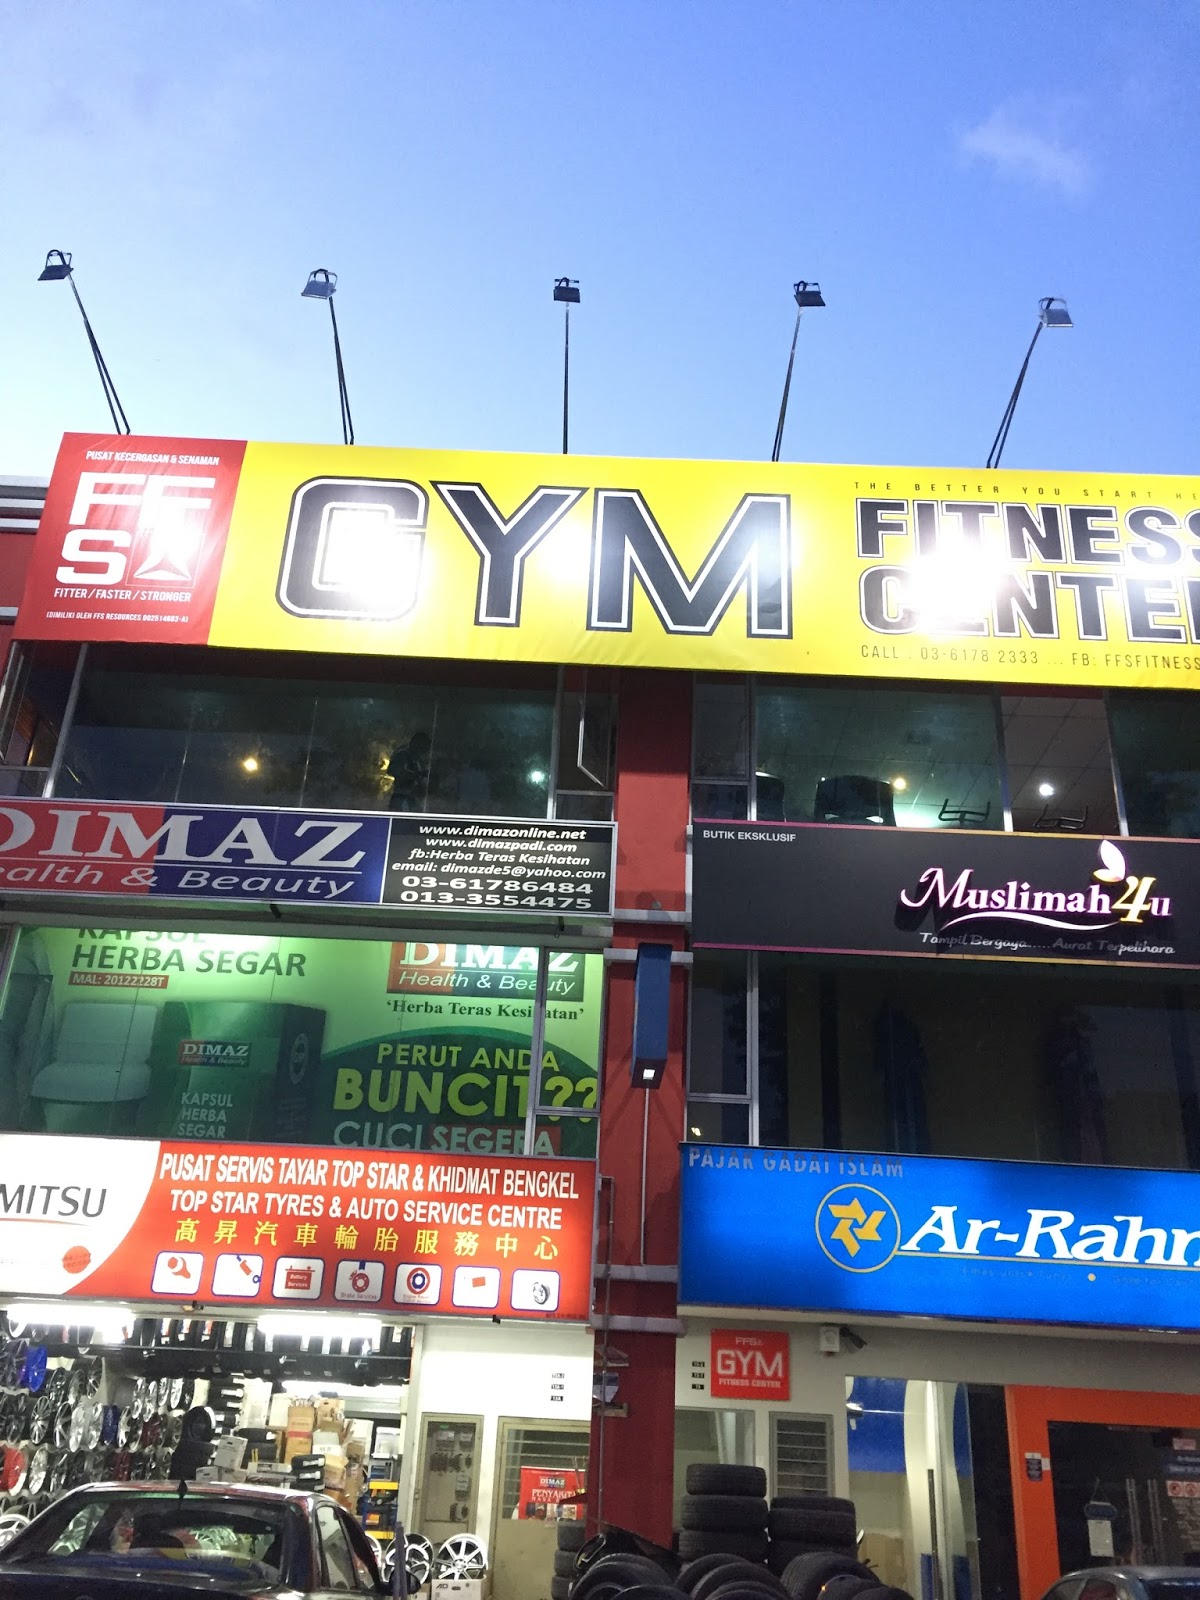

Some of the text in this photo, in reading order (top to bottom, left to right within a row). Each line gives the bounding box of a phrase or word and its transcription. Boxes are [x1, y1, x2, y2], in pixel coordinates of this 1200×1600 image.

[86, 450, 114, 461] PUSAT
[170, 455, 177, 464] &
[178, 456, 220, 466] SENAMAN
[854, 481, 892, 491] THE
[914, 483, 999, 494] BETTER
[1022, 487, 1061, 497] YOU
[1083, 489, 1154, 499] START
[856, 497, 1200, 567] FITNES
[275, 475, 794, 640] GYM
[53, 587, 88, 600] FITTER
[95, 589, 131, 601] FASTER
[139, 590, 193, 603] STRONGER
[92, 613, 105, 621] FFS
[105, 613, 142, 622] RESOURCES
[861, 645, 900, 659] CALL
[920, 647, 990, 663] 03-6178
[998, 650, 1039, 665] 2333
[419, 825, 588, 840] www.dimazonline.net
[703, 830, 796, 842] BUTIK EKSKLUSIF
[425, 838, 578, 853] www.dimazpadi.com
[408, 848, 591, 866] fb:Herba Teras Kesihatan
[391, 862, 606, 880] email: dimazde5@yahoo.com
[120, 867, 158, 888] &
[177, 870, 355, 900] Beauty
[402, 876, 593, 894] 03-61786484
[400, 890, 592, 909] 013-3554475
[920, 932, 967, 946] Tampil
[1098, 940, 1175, 956] Terpelihara
[72, 944, 307, 977] HERBA SEGAR
[72, 973, 102, 985] MAL:
[398, 971, 468, 987] Health
[476, 974, 491, 989] &
[448, 1002, 492, 1016] Teras
[496, 1004, 585, 1020] Kesiatan'
[182, 1043, 249, 1057] DIMAZ
[377, 1043, 560, 1072] PERUT ANDA
[180, 1092, 233, 1108] KAPSUL
[181, 1107, 227, 1123] HERBA
[177, 1123, 226, 1139] SEGAR
[333, 1120, 423, 1151] CUCI
[688, 1148, 904, 1178] PAJAK GADAI ISLAM
[159, 1153, 579, 1199] PUSAT SERVIS TAYAR TOP STAR & KHIDMAT BENGKEL
[170, 1189, 563, 1230] TOP STAR TYRES & AUTO SERVICE CENTRE
[175, 1217, 559, 1260] 高昇汽車輪胎服務中心
[717, 1349, 784, 1379] GYM
[719, 1378, 782, 1389] FITNESS CENTER
